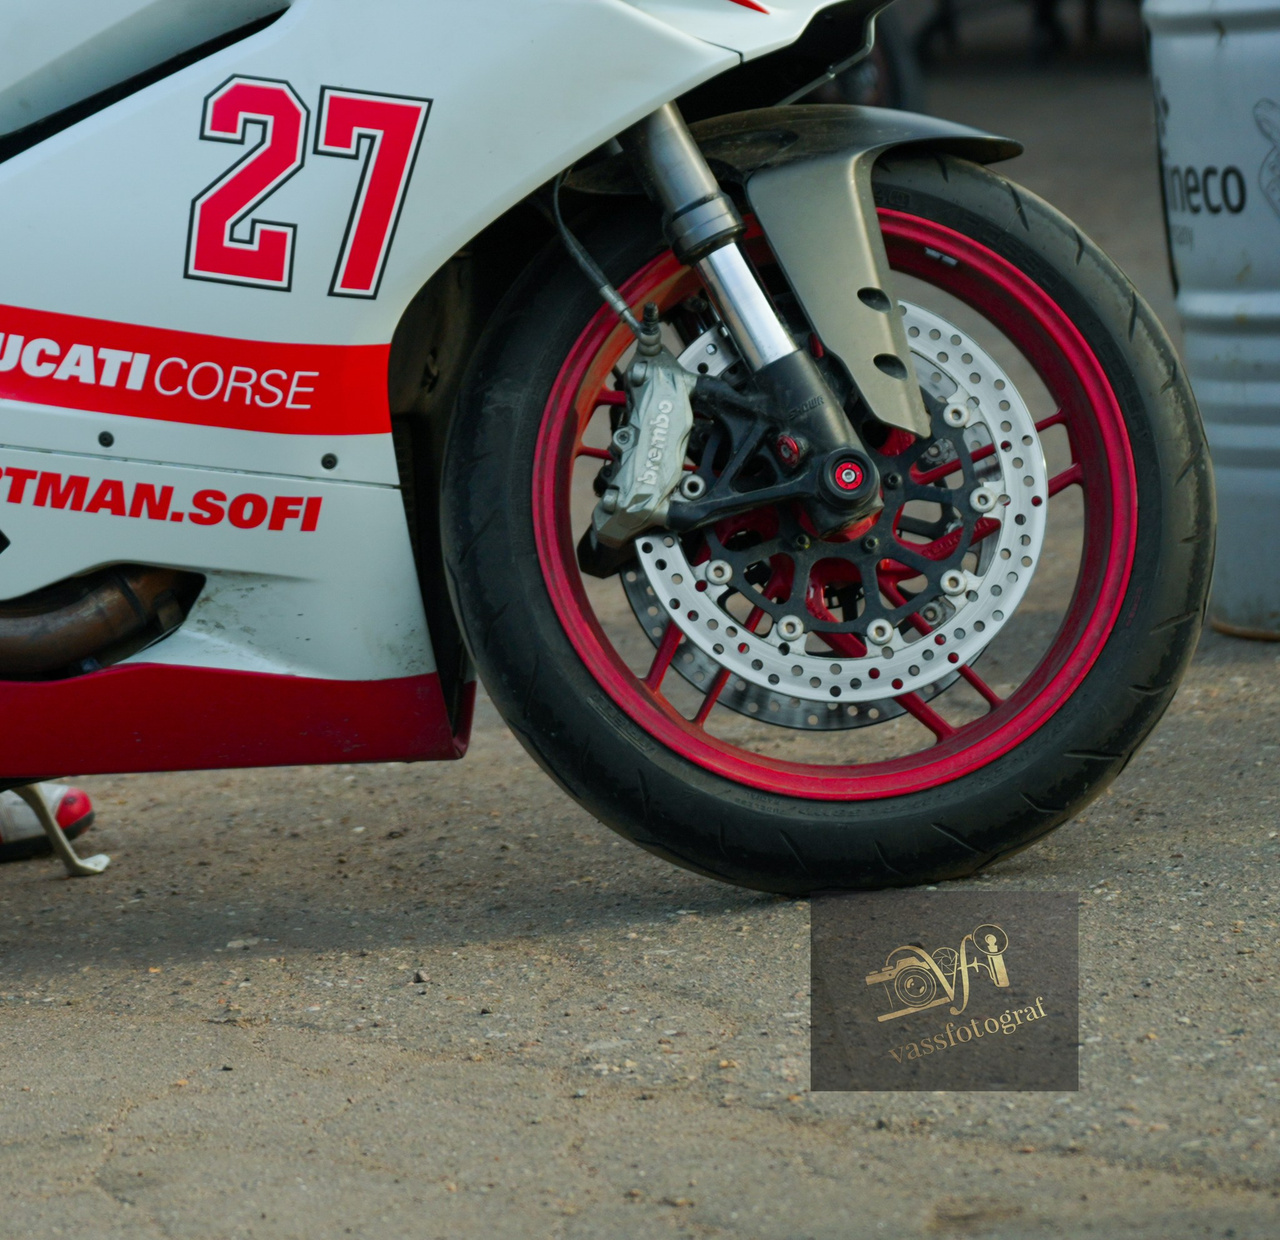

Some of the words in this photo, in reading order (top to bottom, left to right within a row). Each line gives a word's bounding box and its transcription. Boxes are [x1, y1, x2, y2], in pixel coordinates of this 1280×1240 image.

[183, 73, 434, 300] 27
[153, 356, 319, 410] CORSE
[637, 400, 674, 486] brembo
